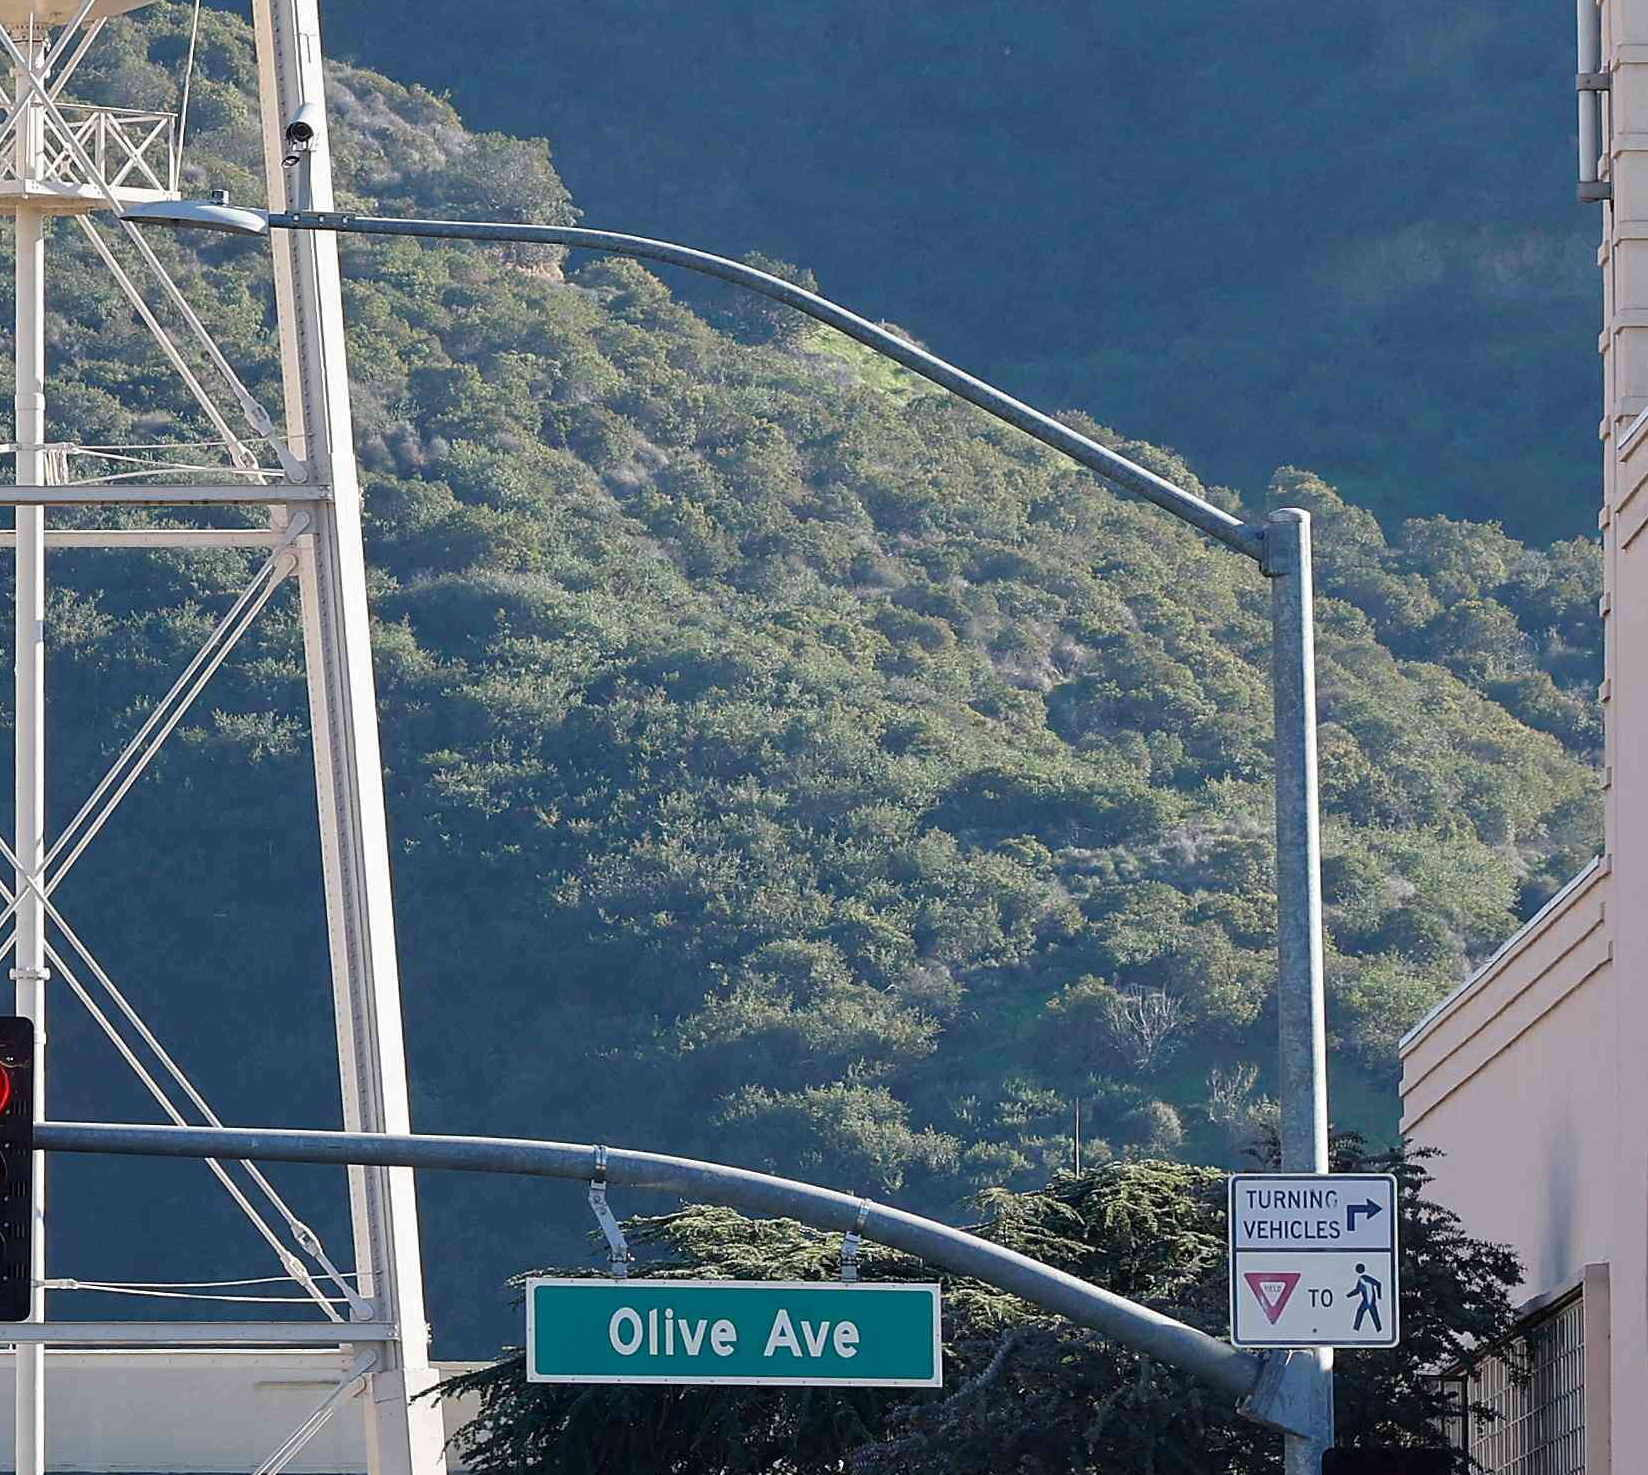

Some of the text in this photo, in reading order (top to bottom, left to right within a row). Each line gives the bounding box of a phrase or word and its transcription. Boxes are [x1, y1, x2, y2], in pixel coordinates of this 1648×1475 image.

[1245, 1190, 1338, 1209] TURNING
[1243, 1220, 1341, 1239] VEHICLES
[1307, 1289, 1333, 1308] TO
[608, 1307, 860, 1359] Olive Ave
